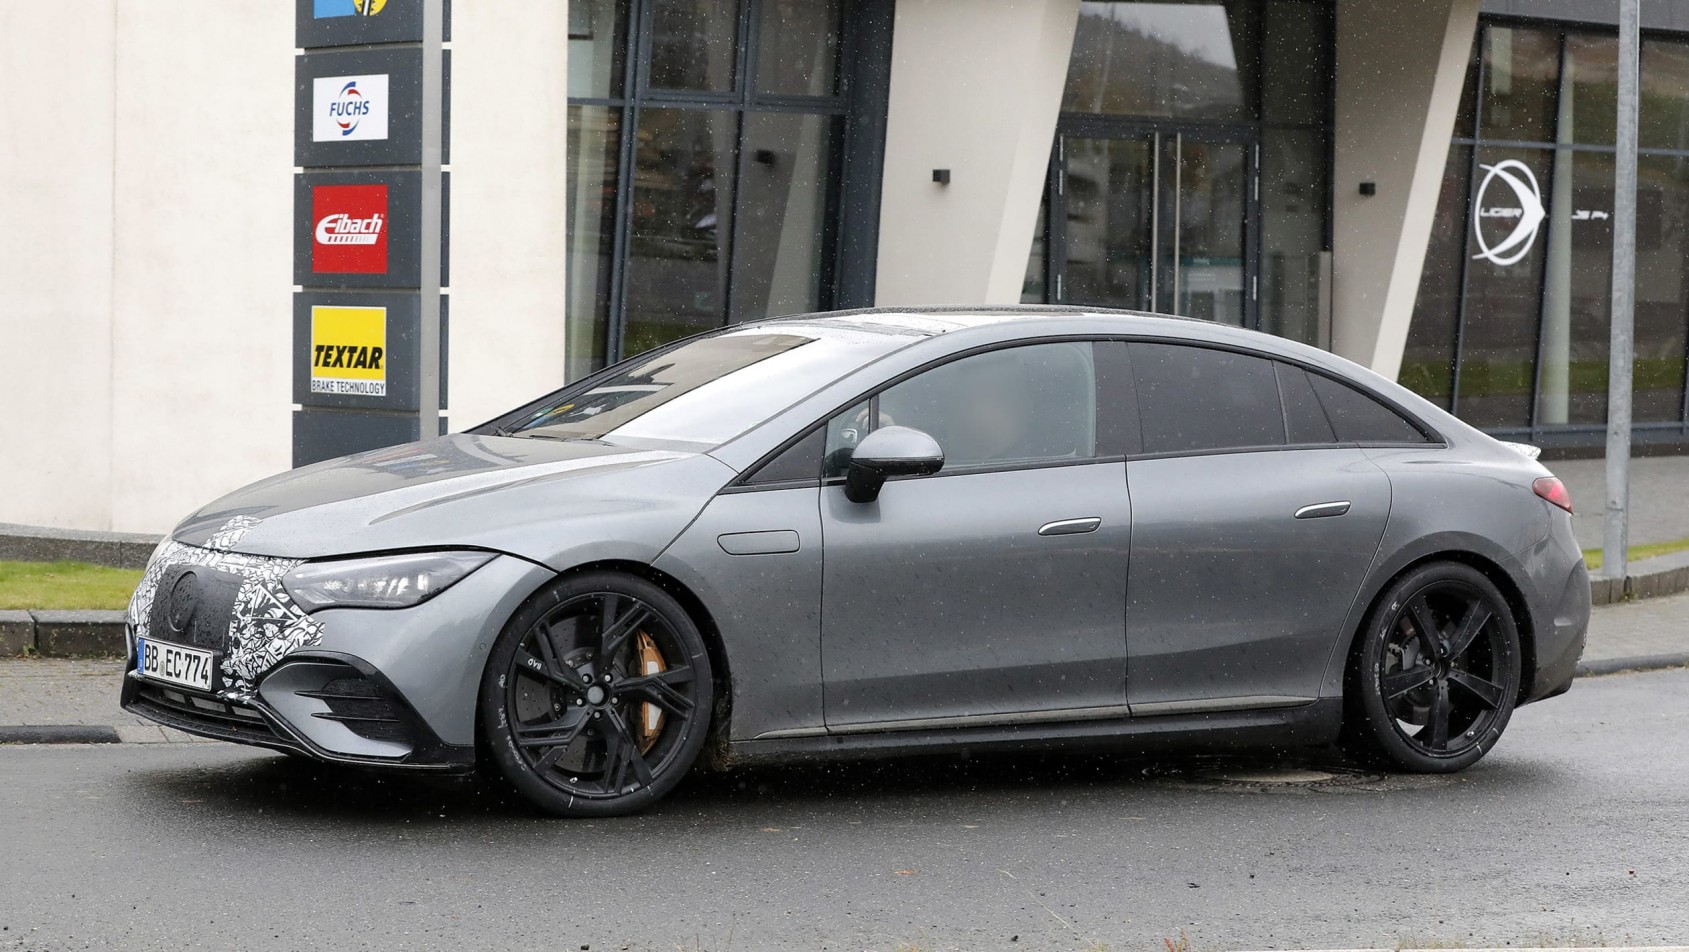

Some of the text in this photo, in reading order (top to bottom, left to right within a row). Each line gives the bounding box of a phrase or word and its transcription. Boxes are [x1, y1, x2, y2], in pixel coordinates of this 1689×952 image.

[329, 101, 370, 117] FUCHS
[315, 213, 383, 244] Eibach
[314, 345, 383, 369] TEXTAR
[312, 380, 385, 395] BRAKE TECHNOLOGY
[145, 644, 158, 672] BB
